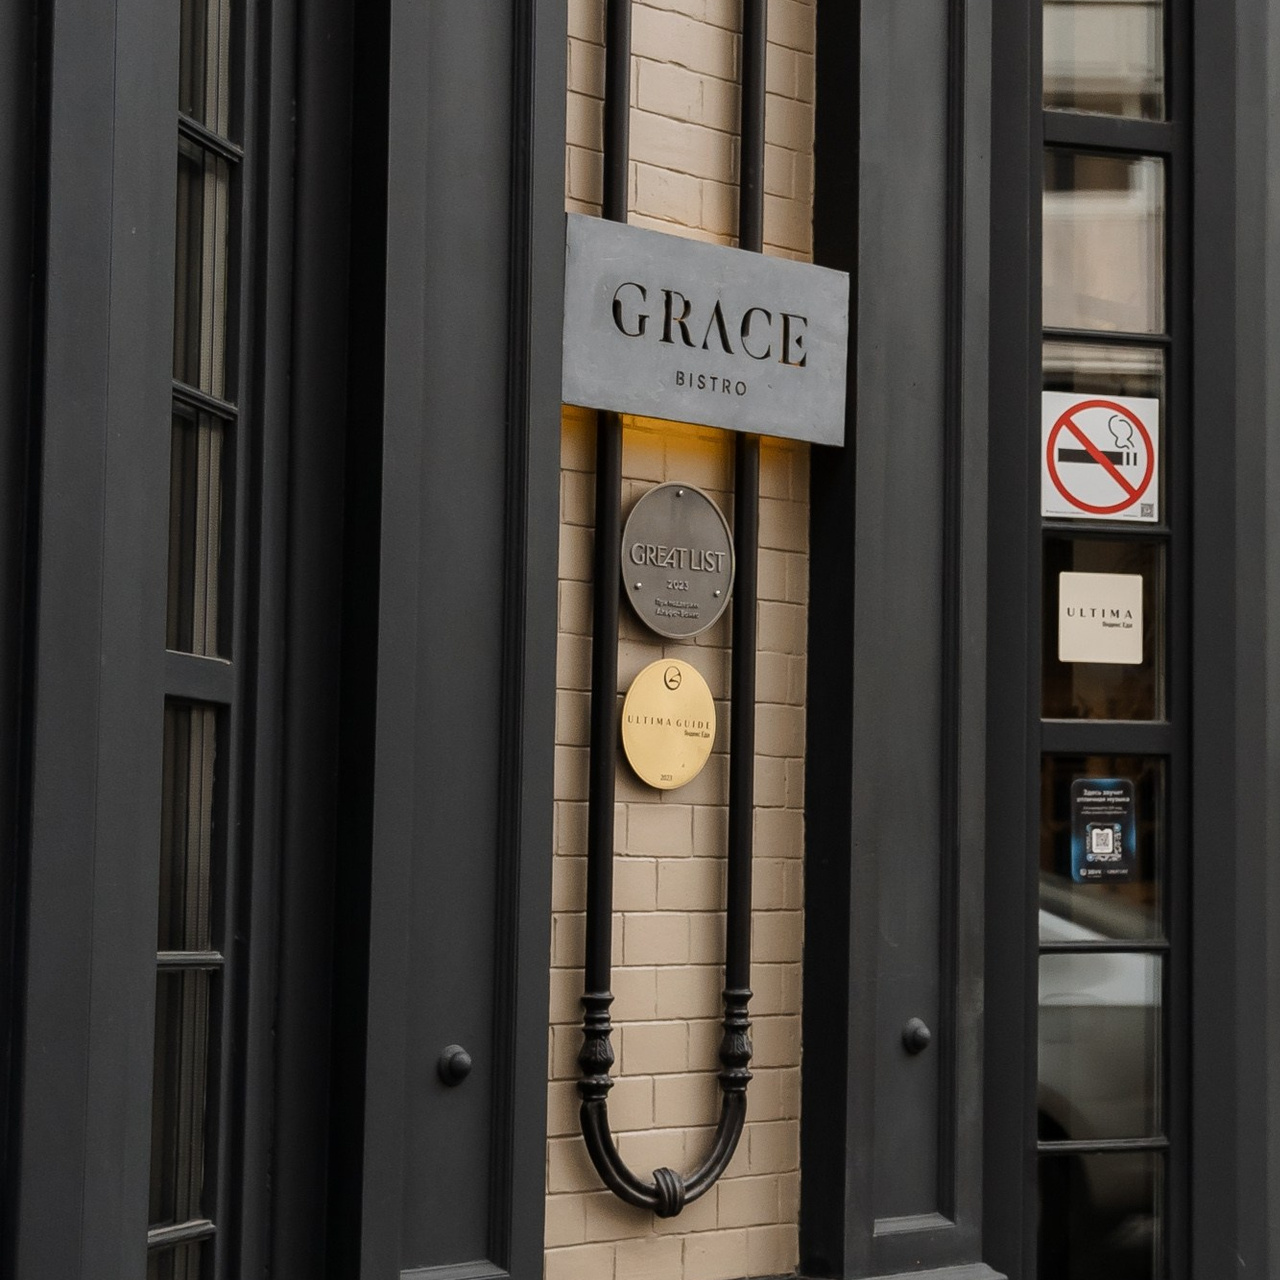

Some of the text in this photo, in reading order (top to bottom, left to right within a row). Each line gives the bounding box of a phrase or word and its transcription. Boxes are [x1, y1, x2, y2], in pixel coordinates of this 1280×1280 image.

[612, 282, 808, 367] GRACE
[676, 371, 747, 396] BISTRO
[630, 543, 726, 572] GREAT LIST
[667, 580, 689, 591] 2023
[1067, 607, 1133, 619] ULTIMA
[627, 715, 711, 730] ULTIMA GUIDE
